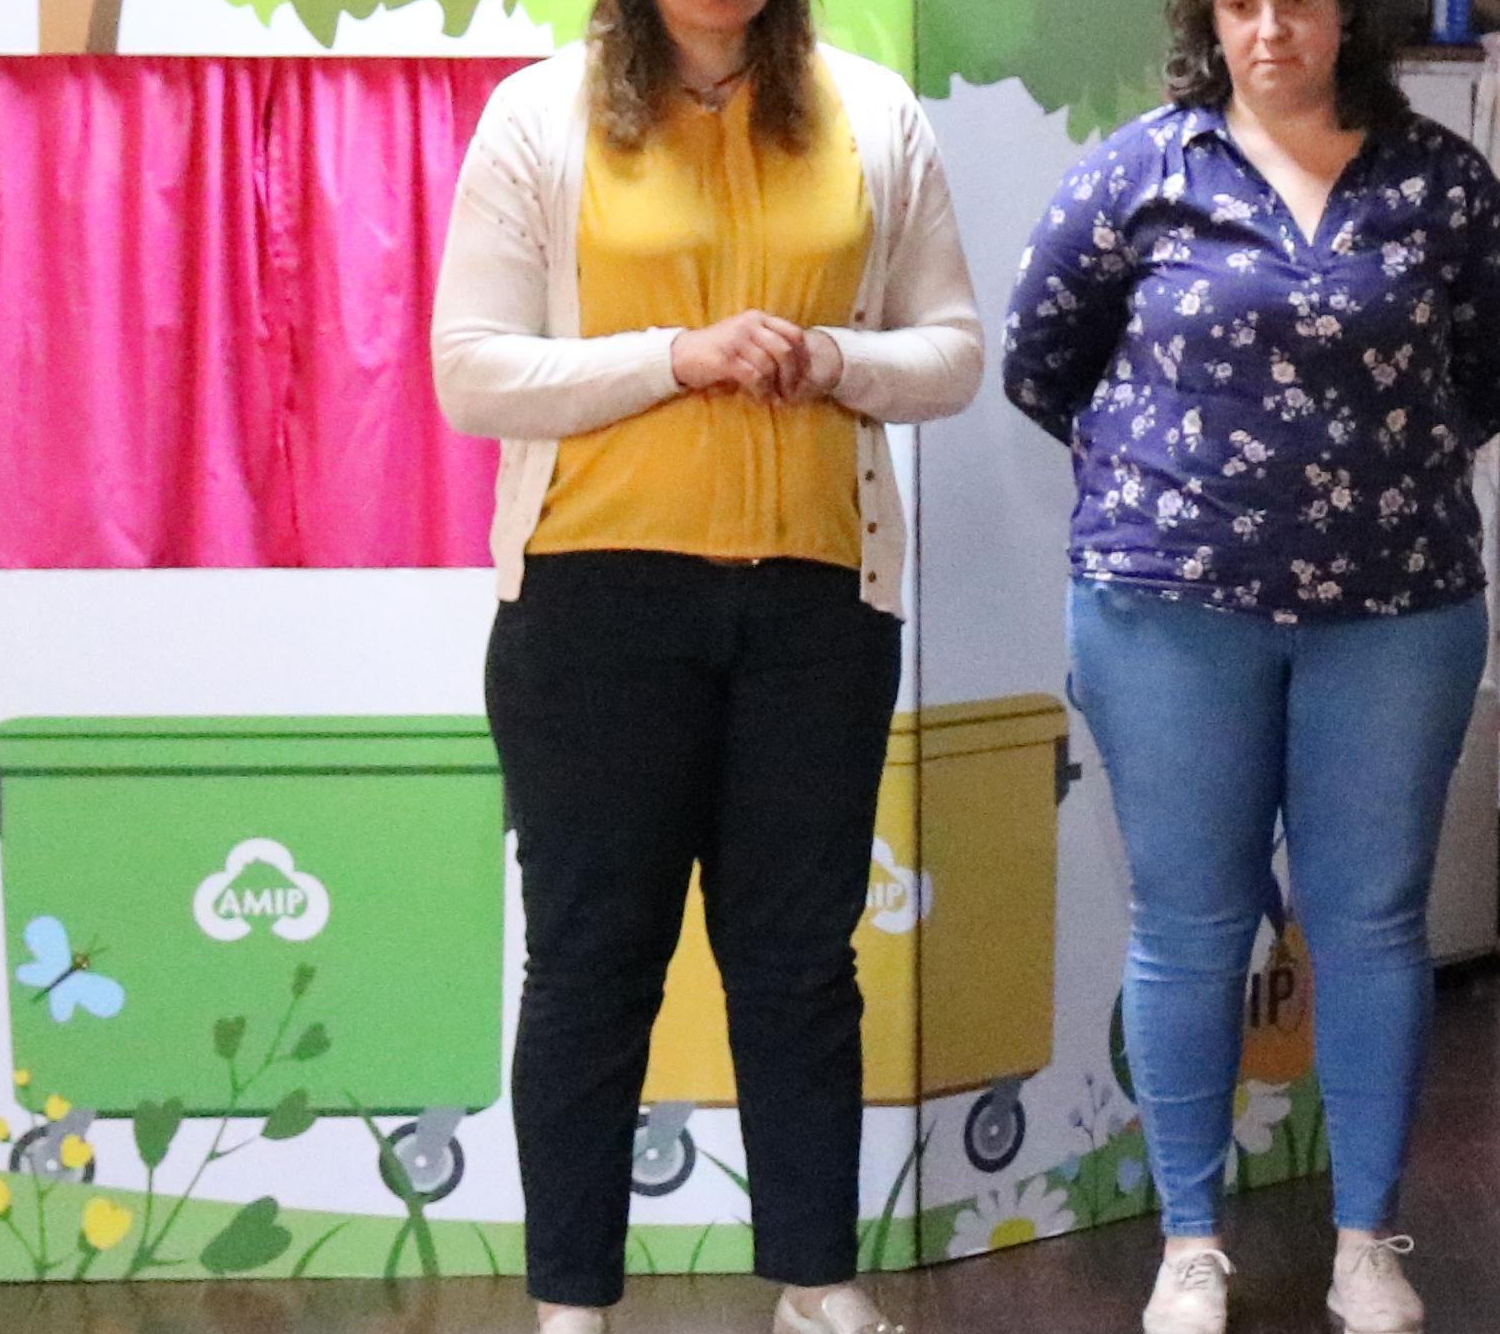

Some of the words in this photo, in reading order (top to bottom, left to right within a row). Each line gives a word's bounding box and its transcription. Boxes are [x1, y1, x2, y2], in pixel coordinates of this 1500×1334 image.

[219, 887, 305, 916] AMIP
[865, 881, 904, 908] IP
[1250, 968, 1295, 1029] IP
